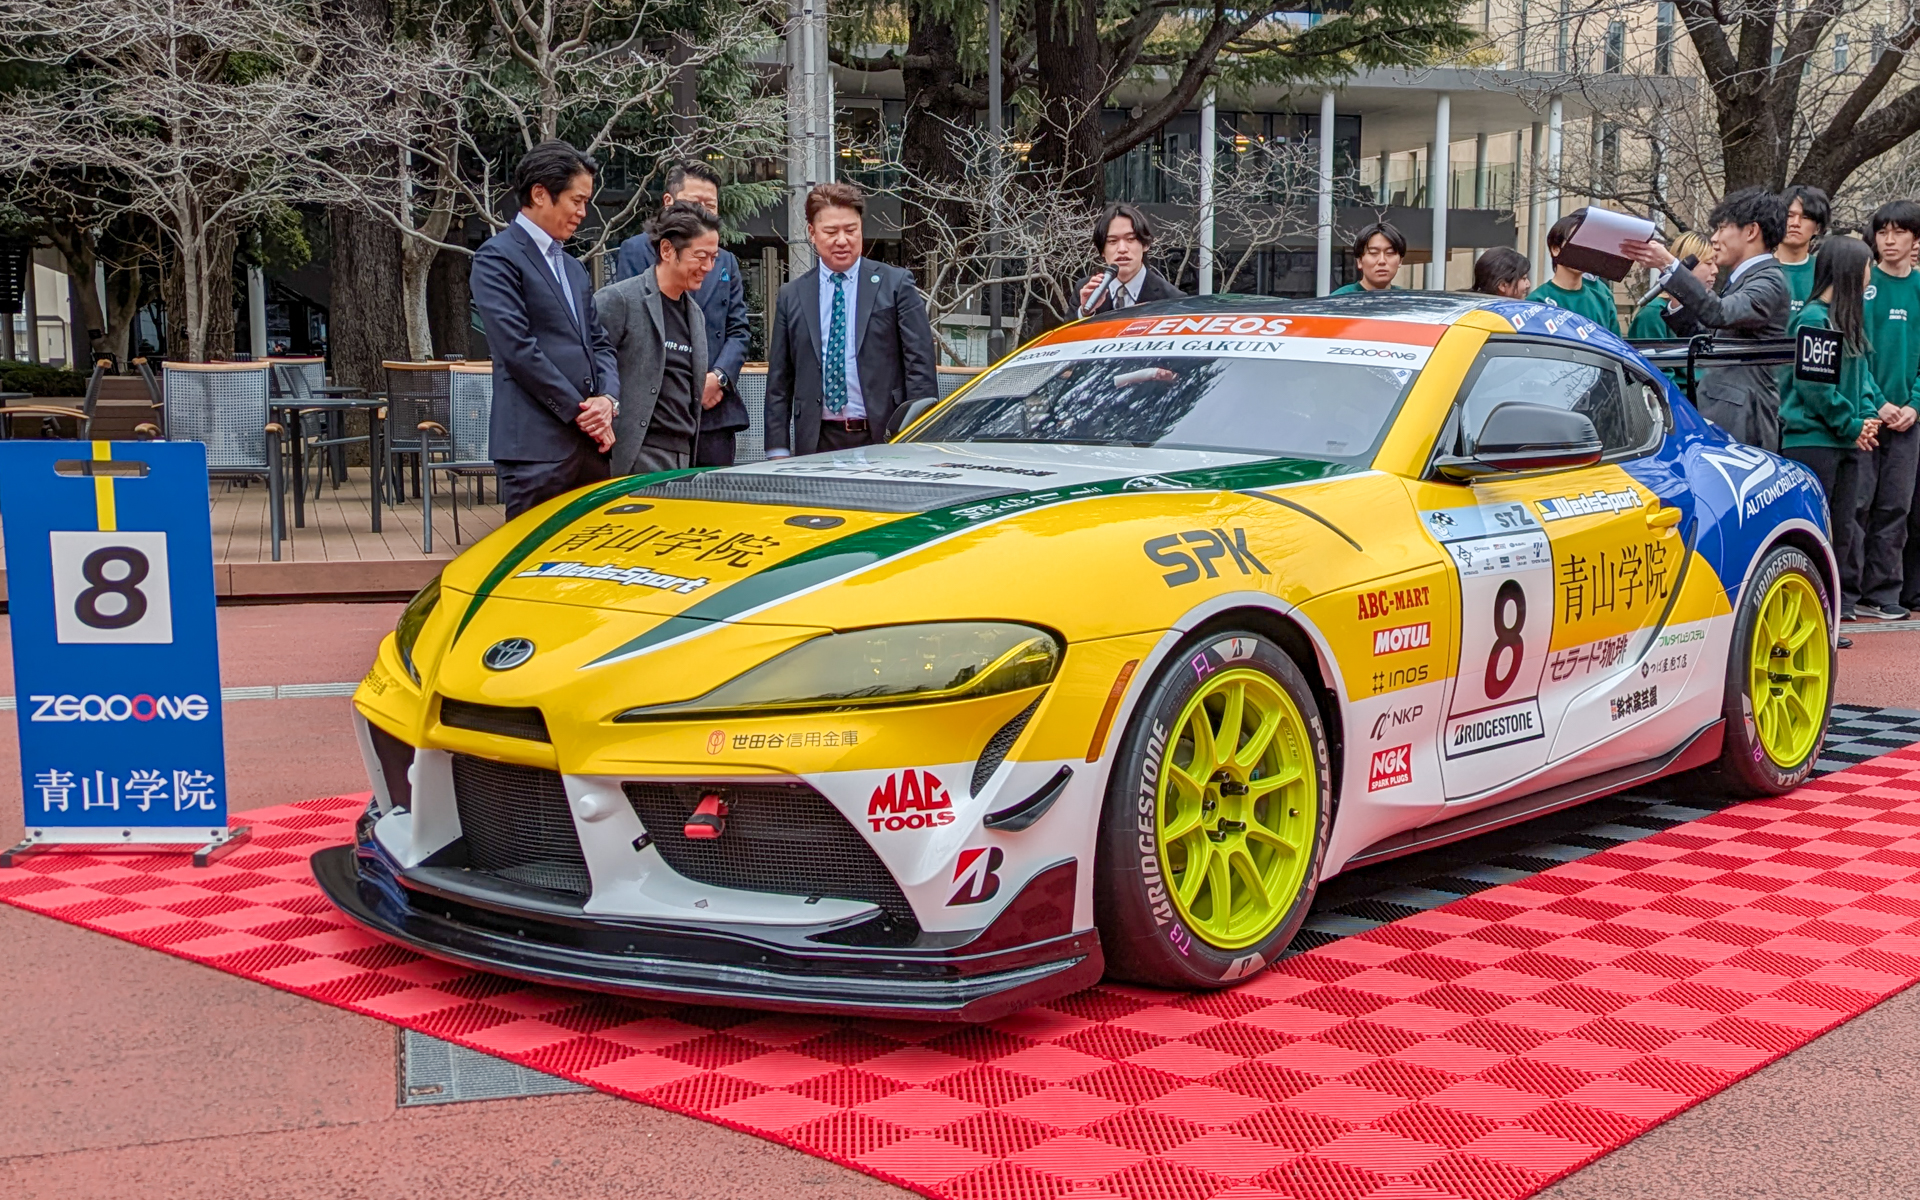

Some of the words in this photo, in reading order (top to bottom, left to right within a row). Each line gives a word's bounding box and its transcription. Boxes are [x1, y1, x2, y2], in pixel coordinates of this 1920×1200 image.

[1150, 317, 1293, 336] ENEOS
[1082, 340, 1175, 355] AOYAMA
[1183, 340, 1286, 354] GAKUIN
[1550, 486, 1644, 519] WedsSport
[1746, 470, 1797, 519] AUTOMOBILE
[550, 523, 781, 568] 青山学院
[1143, 528, 1273, 588] SPK
[74, 546, 150, 630] 8
[546, 562, 711, 595] WedsSport
[1559, 540, 1669, 624] 青山学院
[1753, 552, 1809, 613] BRIDGESTONE
[1357, 586, 1430, 620] ABC-MART
[1374, 623, 1430, 655] MOTUL
[1484, 579, 1527, 700] 8
[1659, 630, 1705, 648] フルタイムシステム
[1551, 634, 1629, 682] セラード珈琲
[30, 694, 210, 722] ZEROONE
[1391, 704, 1424, 727] NKP
[732, 730, 860, 750] 世田谷信用金庫
[1454, 711, 1534, 747] BRIDGESTONE
[1371, 746, 1409, 779] NGK
[33, 768, 217, 812] 青山学院
[867, 768, 954, 816] MAC
[1371, 778, 1390, 790] SPARK
[1389, 773, 1409, 786] PLUGS
[867, 811, 956, 833] TOOLS
[1137, 717, 1174, 926] BRIDGESTONE
